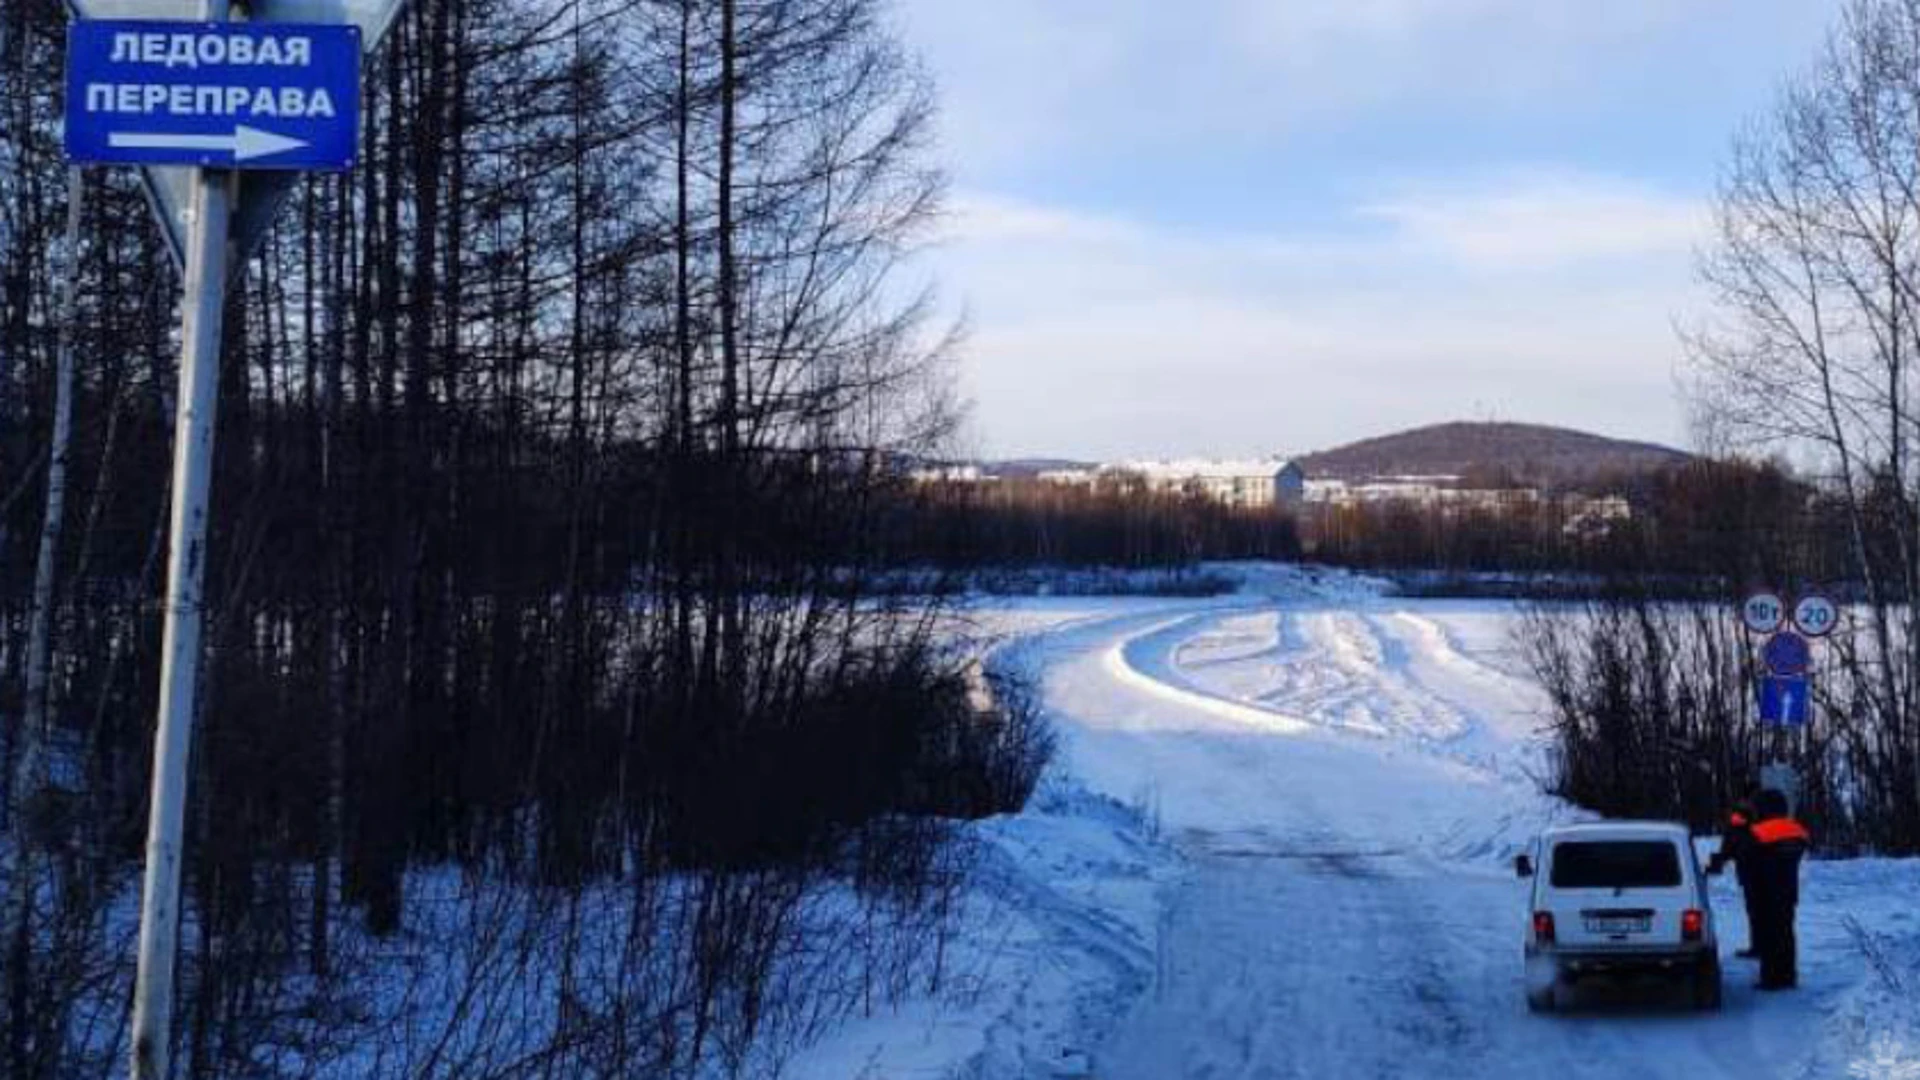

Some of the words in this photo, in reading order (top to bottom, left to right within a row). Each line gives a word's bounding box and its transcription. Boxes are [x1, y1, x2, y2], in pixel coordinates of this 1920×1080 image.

[109, 32, 311, 69] ЛЕДОВАЯ
[86, 83, 335, 117] ПЕРЕПРАВА
[1801, 606, 1829, 624] 20
